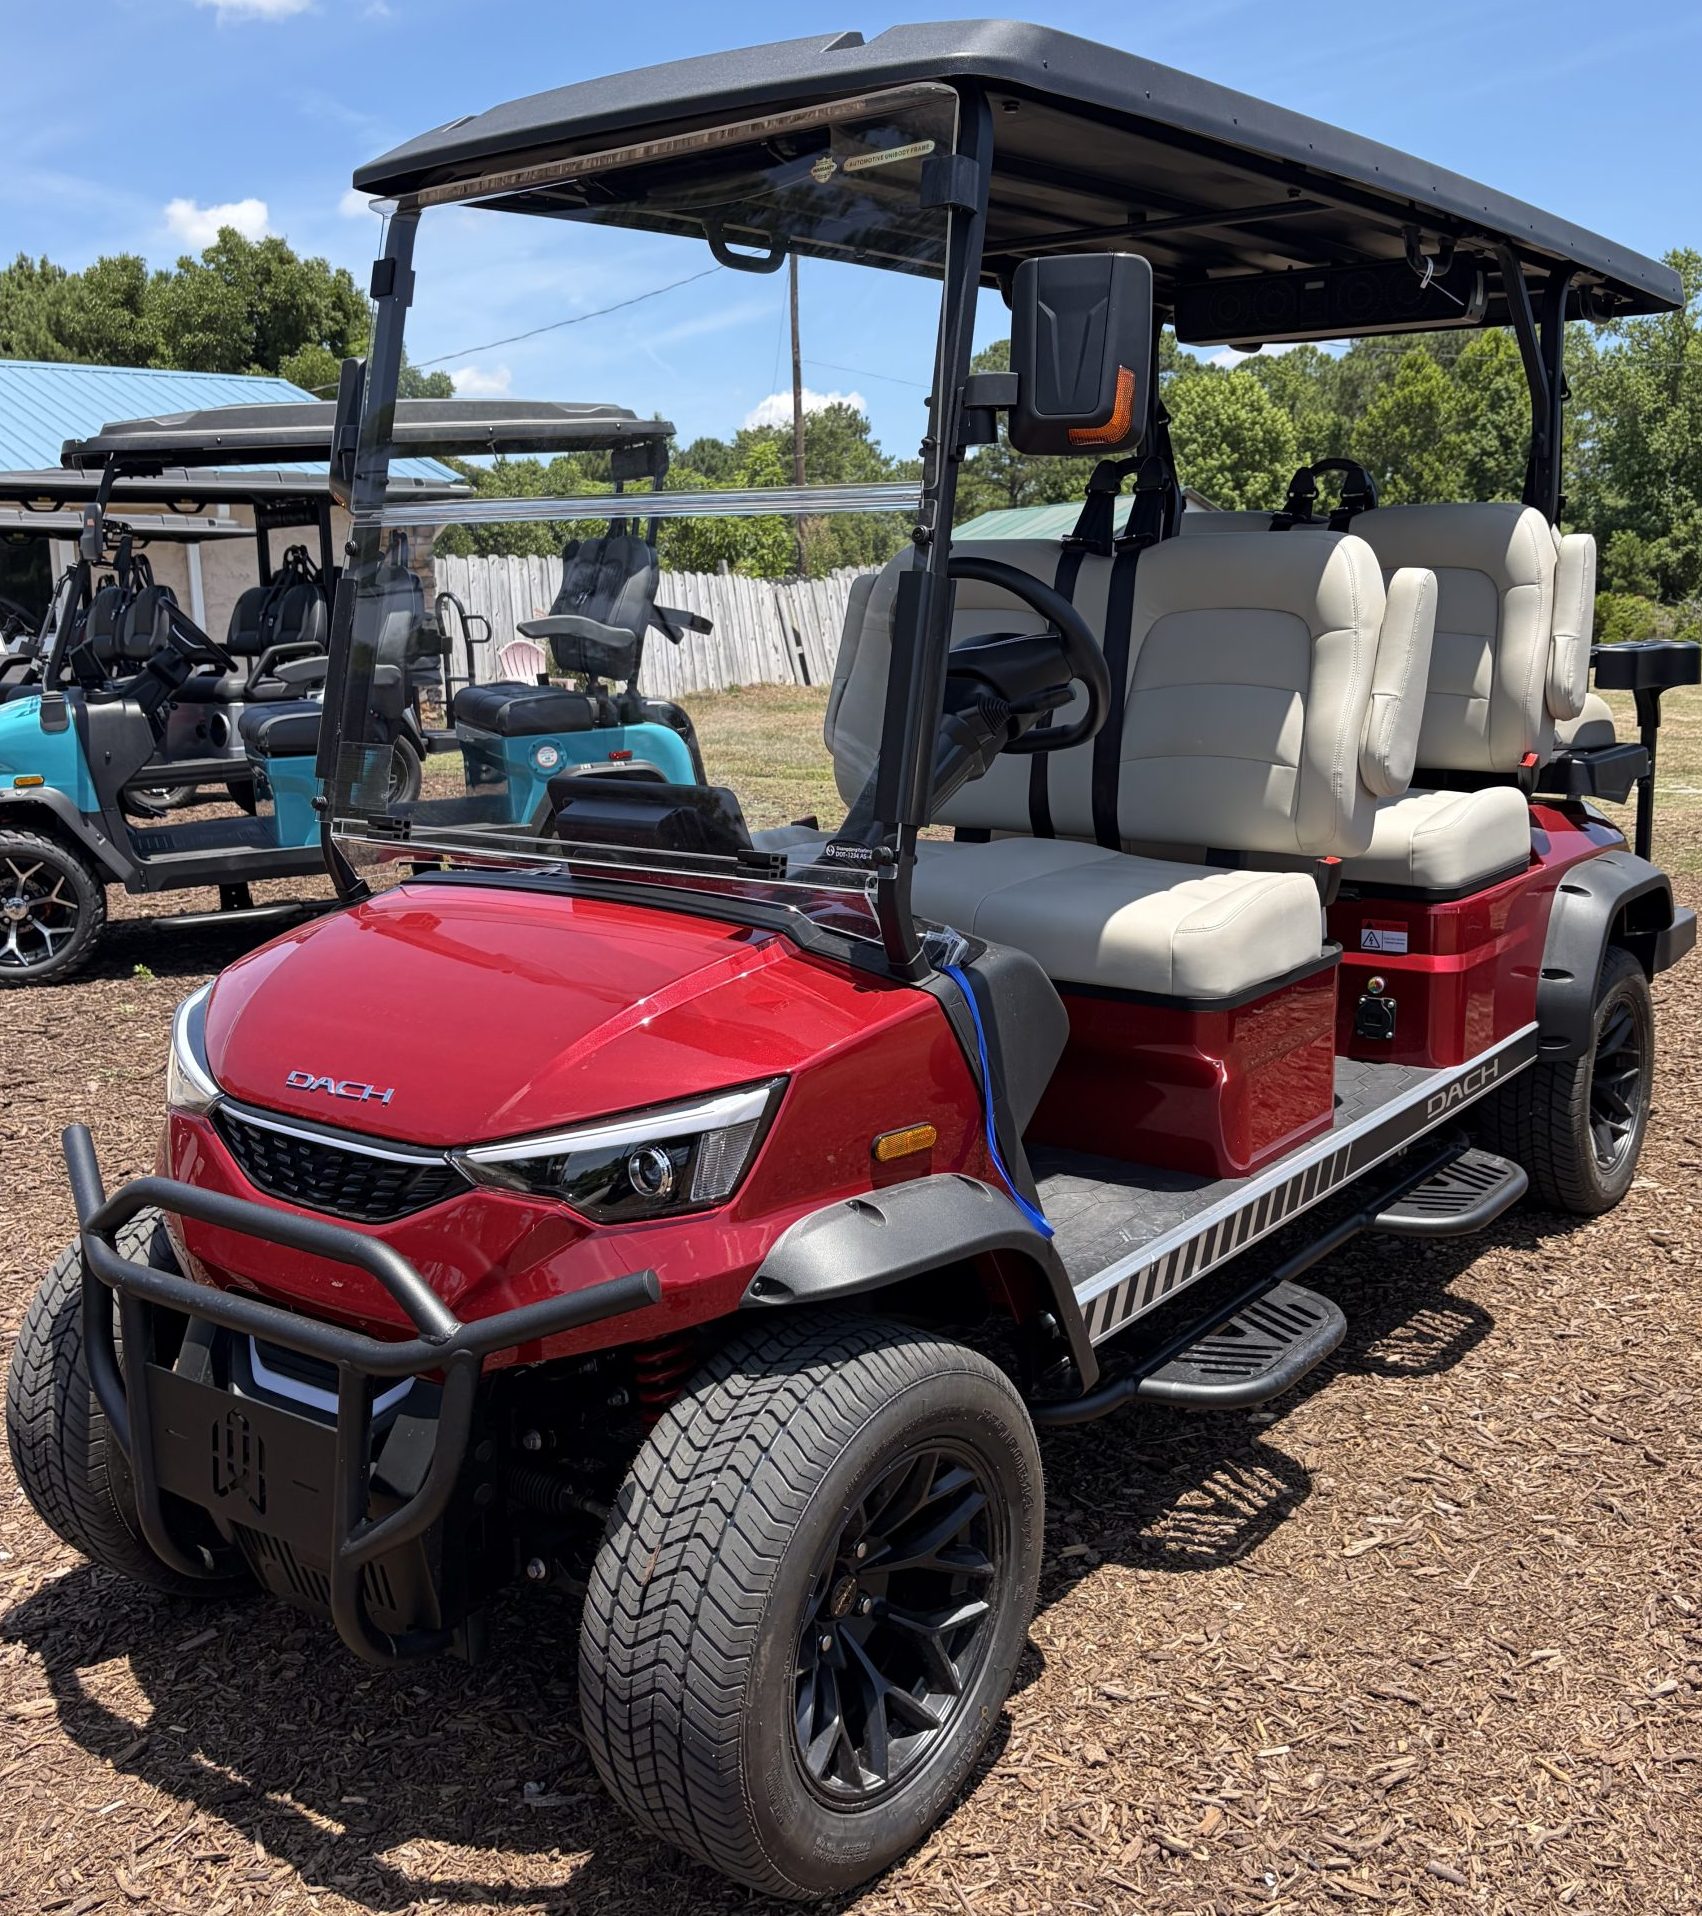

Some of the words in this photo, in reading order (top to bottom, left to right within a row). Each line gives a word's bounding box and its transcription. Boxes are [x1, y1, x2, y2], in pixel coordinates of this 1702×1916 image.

[849, 155, 883, 167] AUTOMOTIVE
[884, 148, 910, 160] UNIBODY
[911, 143, 930, 154] FRAME
[285, 1070, 395, 1106] DACH
[1427, 1058, 1499, 1119] DACH
